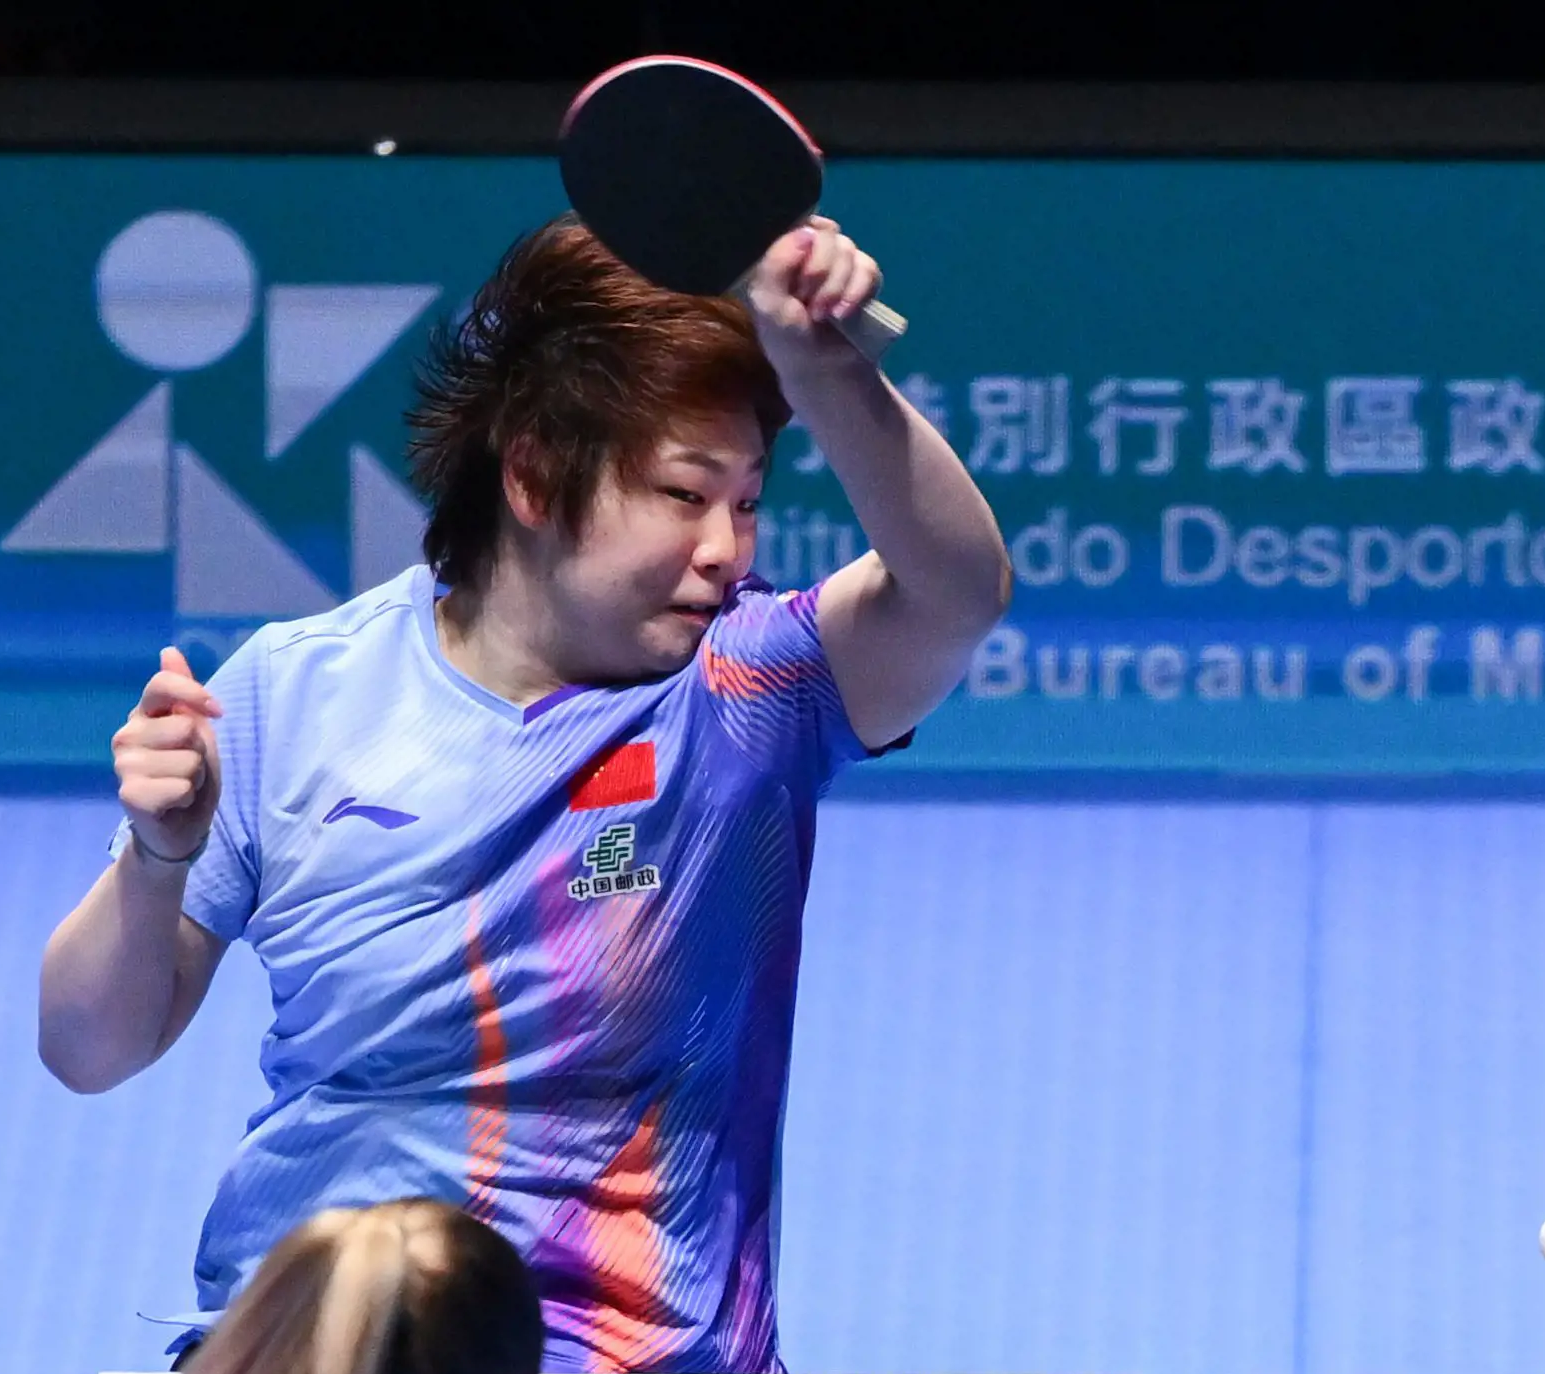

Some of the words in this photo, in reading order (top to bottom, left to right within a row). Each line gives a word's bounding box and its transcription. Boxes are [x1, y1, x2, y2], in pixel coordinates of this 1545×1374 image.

[1011, 508, 1130, 588] do
[968, 627, 1308, 701] Bureau
[1341, 627, 1442, 700] of
[570, 867, 657, 898] 中国邮政
